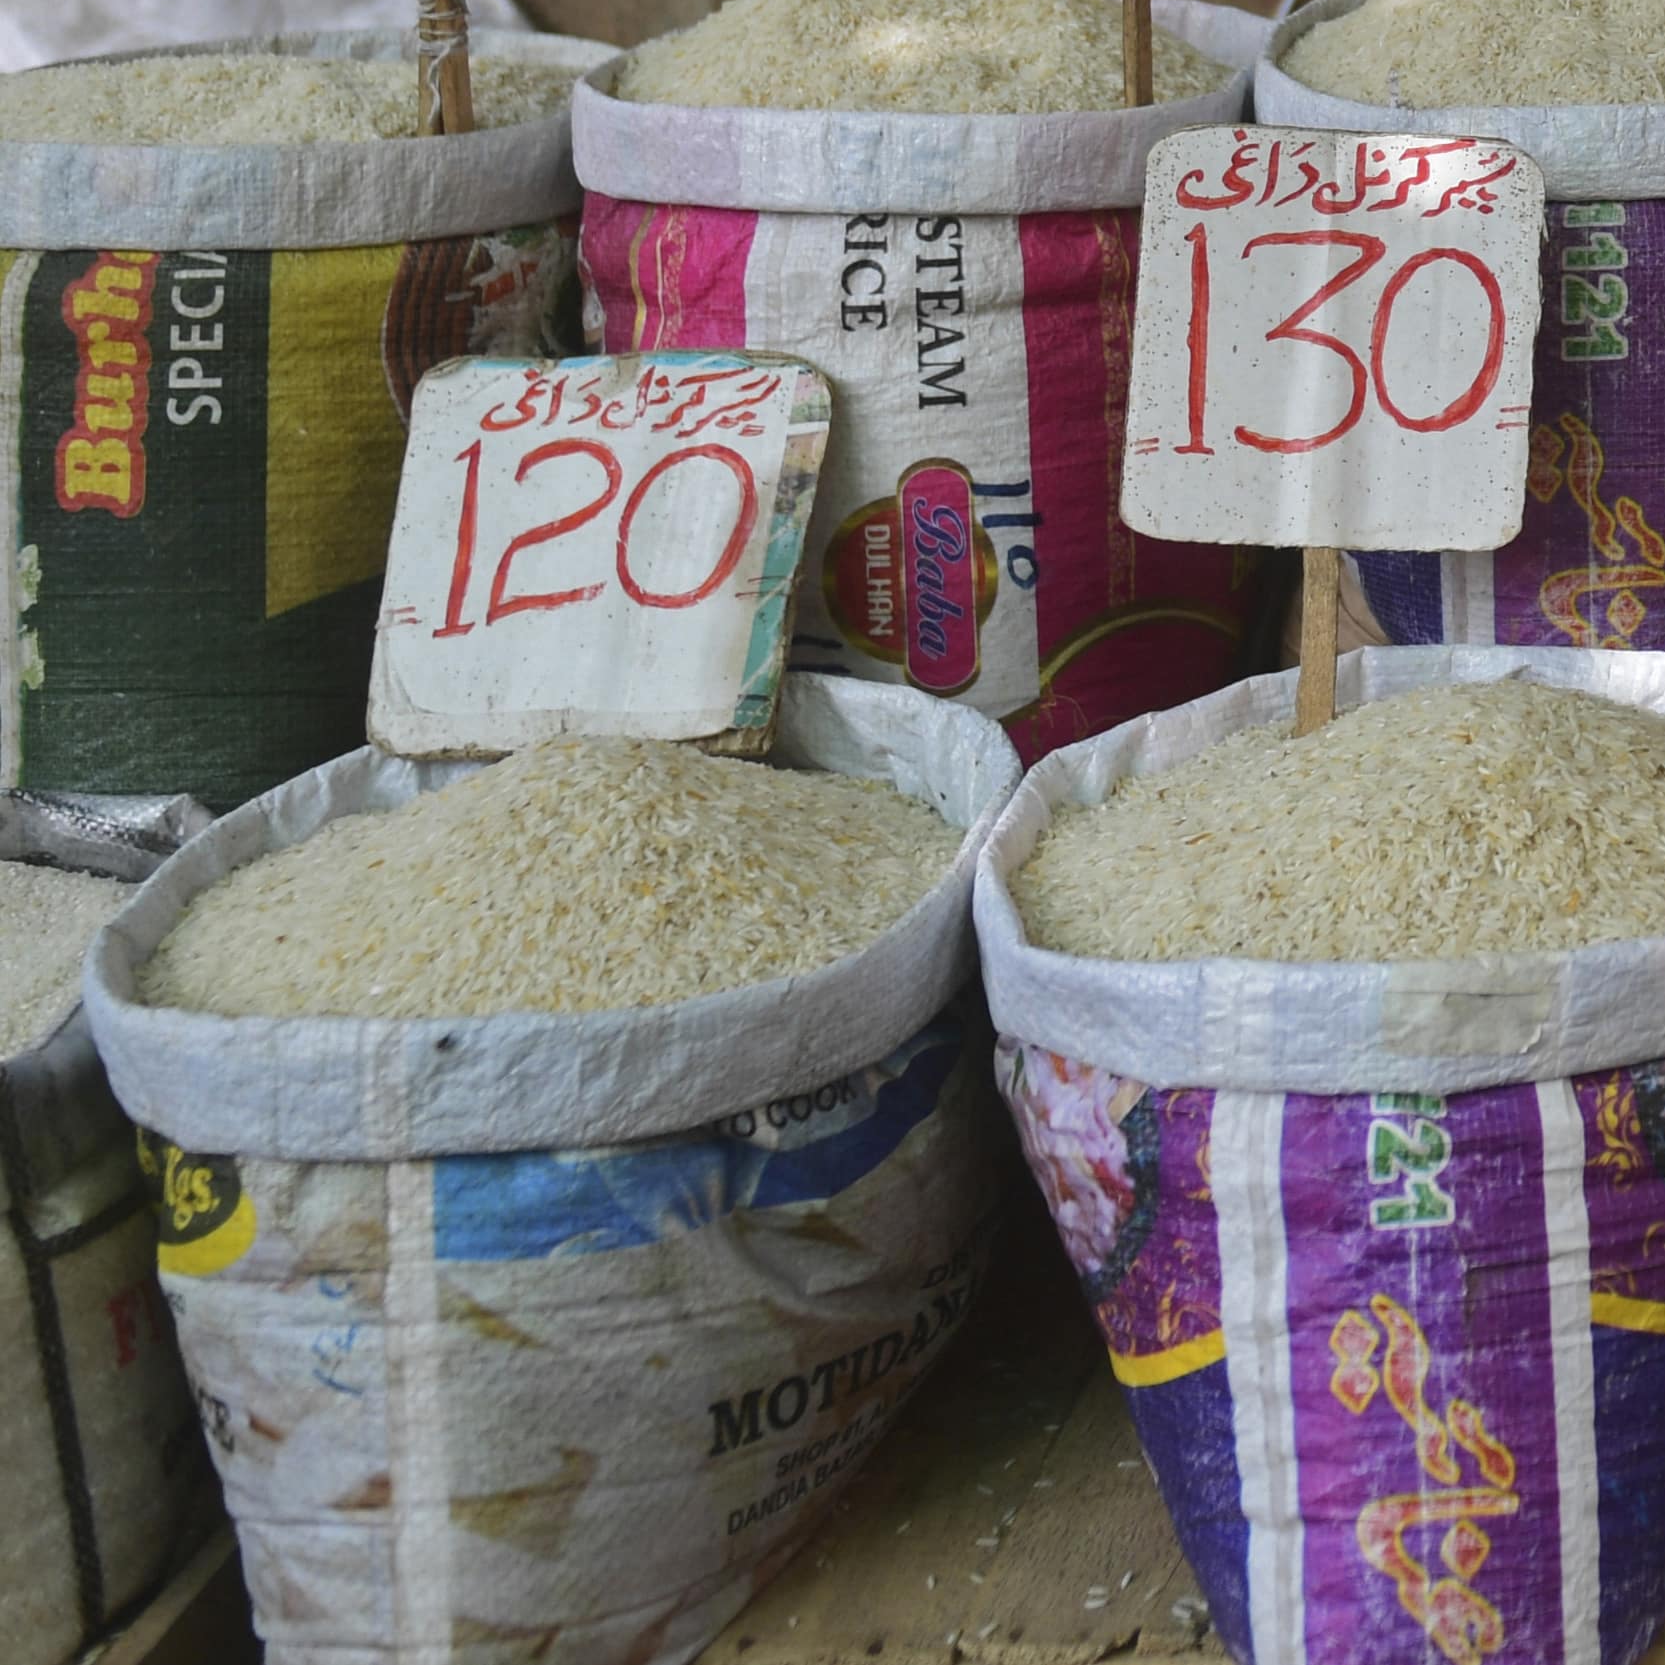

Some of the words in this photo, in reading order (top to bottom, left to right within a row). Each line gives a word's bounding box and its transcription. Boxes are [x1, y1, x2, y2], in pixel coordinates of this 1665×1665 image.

[58, 250, 154, 514] Burh
[915, 214, 968, 411] STEAM
[1173, 222, 1506, 456] 130
[432, 437, 759, 639] 120
[864, 523, 896, 638] DULHAN
[909, 495, 971, 661] Baba
